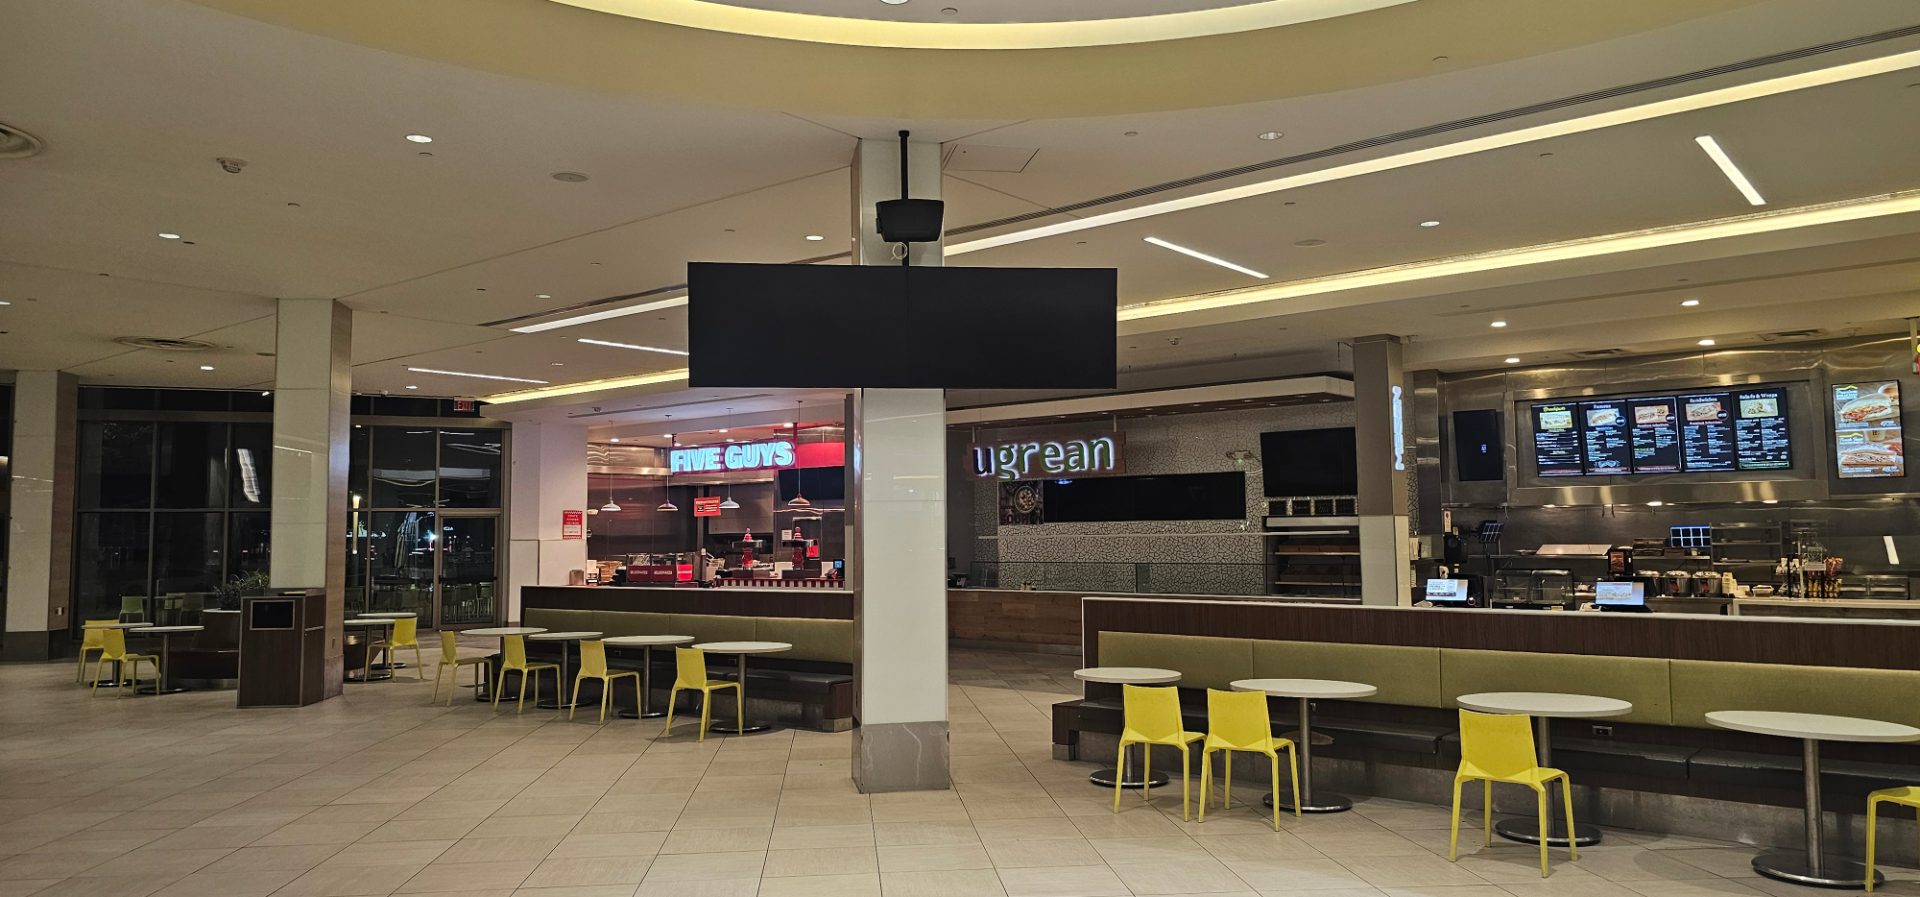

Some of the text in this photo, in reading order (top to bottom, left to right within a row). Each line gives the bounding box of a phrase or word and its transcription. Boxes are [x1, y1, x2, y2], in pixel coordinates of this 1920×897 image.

[671, 441, 794, 473] FIVE GUYS
[972, 437, 1115, 481] ugrean
